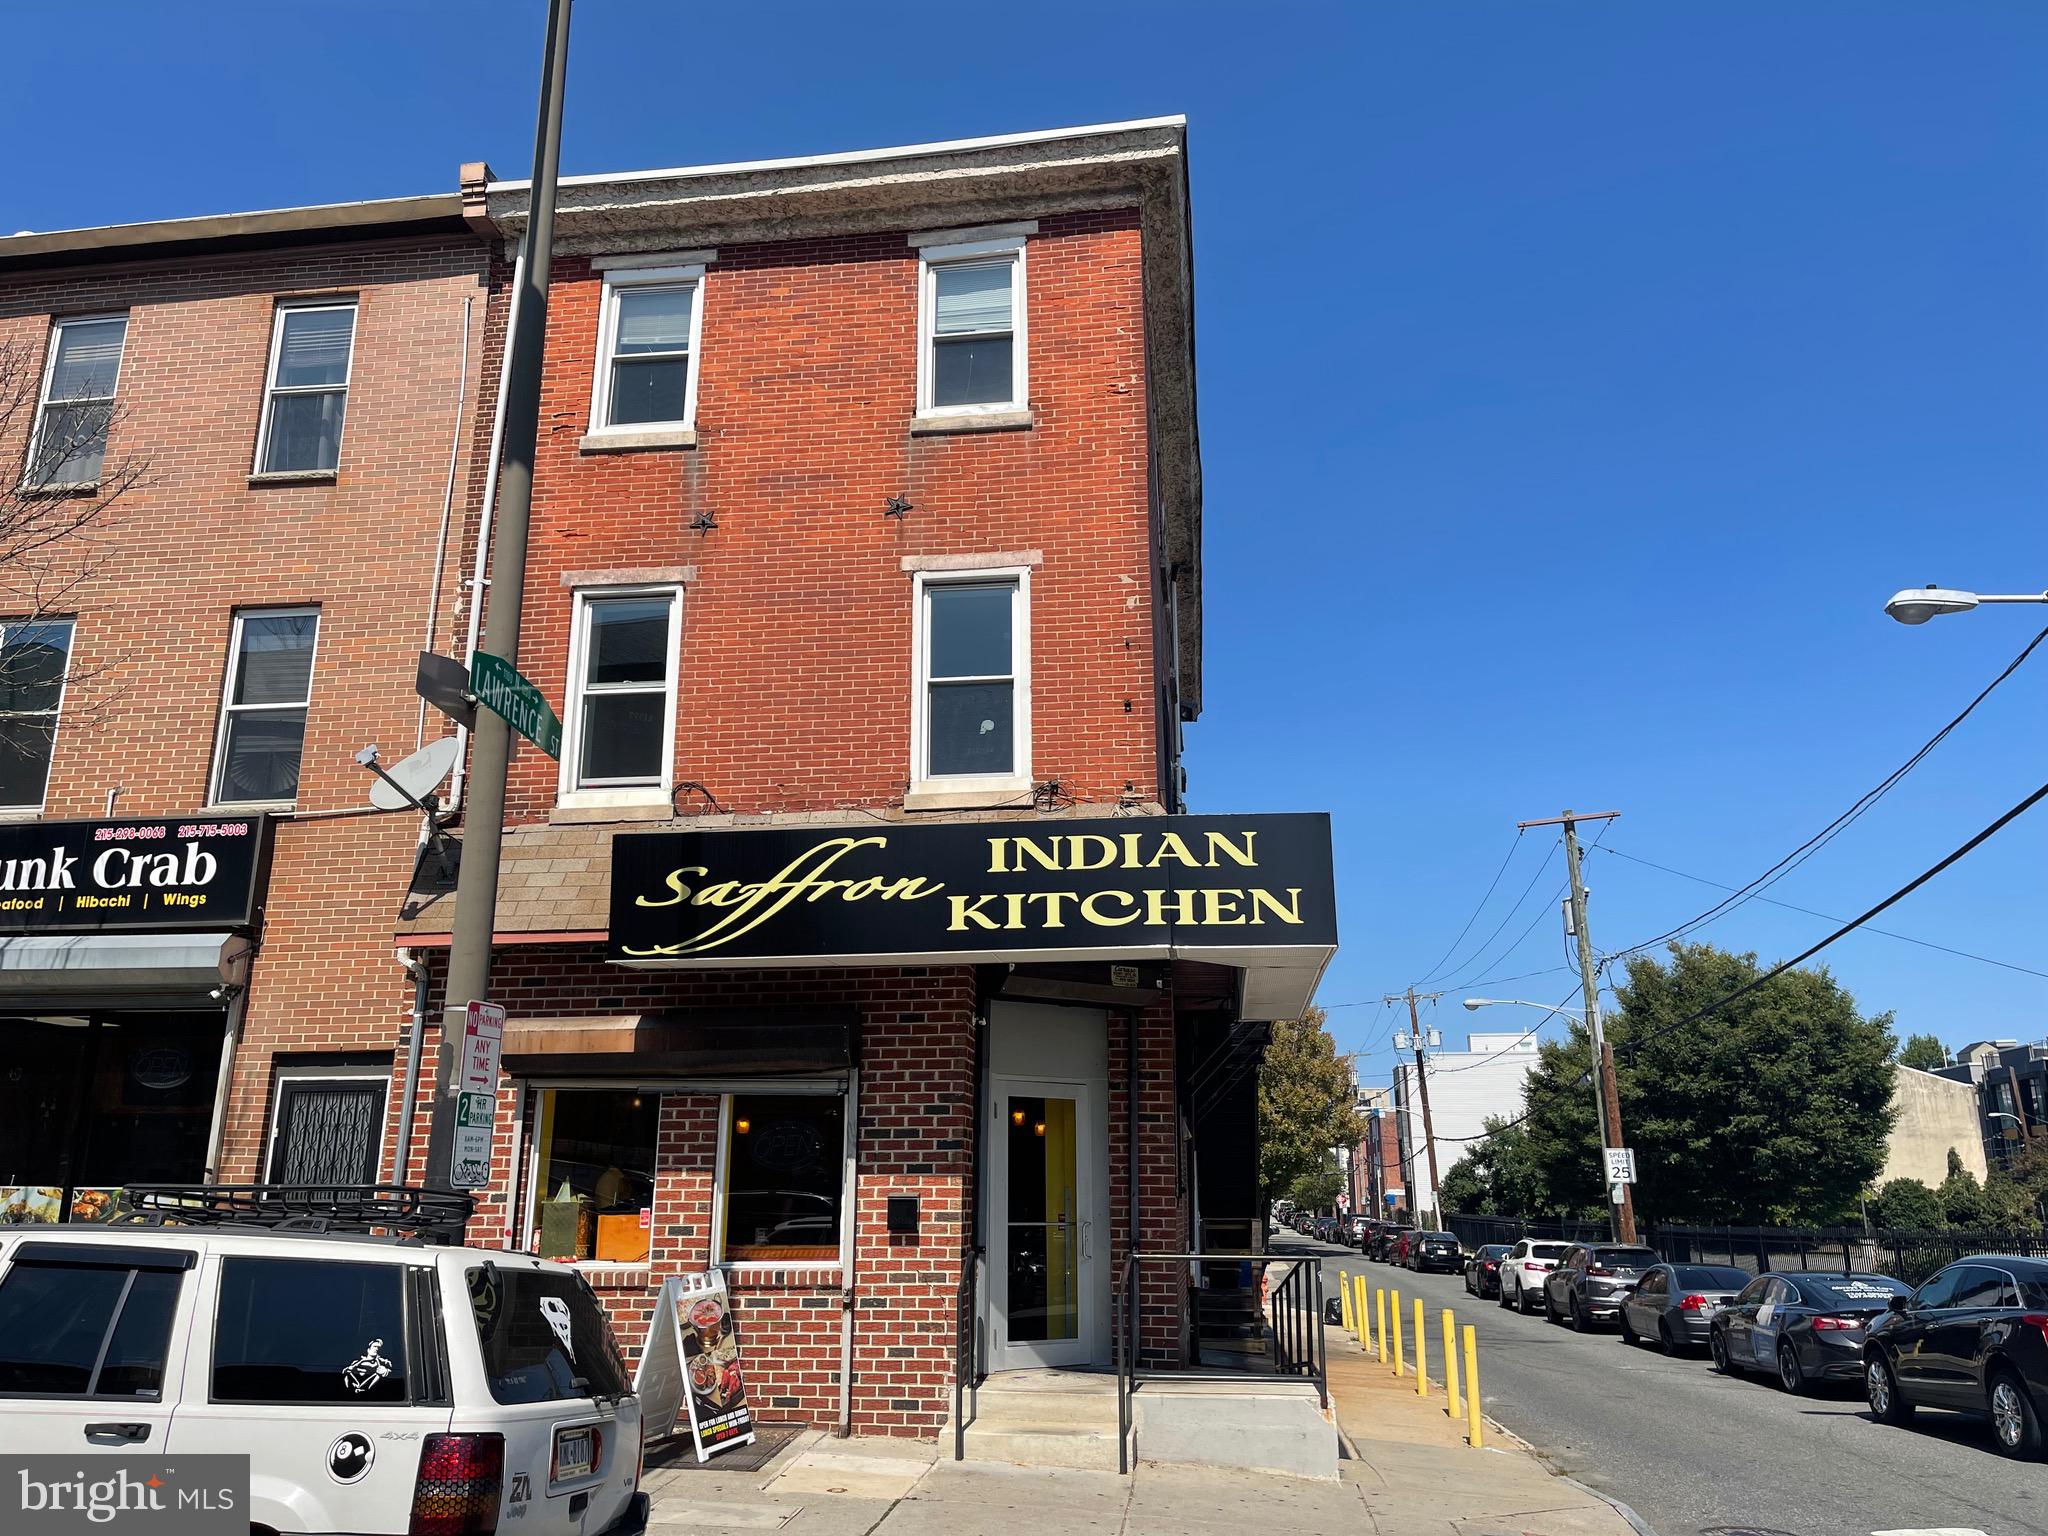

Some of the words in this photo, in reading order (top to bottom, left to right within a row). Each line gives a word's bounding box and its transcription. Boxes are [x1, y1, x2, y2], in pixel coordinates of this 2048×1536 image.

[475, 662, 543, 744] LAWRENCE
[550, 734, 560, 757] ST
[178, 823, 248, 838] 215-715-5003
[986, 831, 1258, 873] INDIAN
[0, 846, 79, 890] unk
[92, 842, 217, 889] Crab
[0, 897, 44, 910] afood
[76, 894, 130, 908] Hibachi
[163, 893, 207, 909] Wings
[622, 836, 946, 956] Saffron
[946, 888, 1304, 931] KITCHEN
[468, 1010, 478, 1028] NO
[479, 1013, 502, 1029] PARKING
[474, 1039, 491, 1055] ANY
[472, 1056, 490, 1072] TIME
[459, 1098, 468, 1122] 2
[469, 1111, 492, 1125] PARKING
[464, 1145, 483, 1154] MON-SAT
[1612, 1166, 1631, 1179] 25
